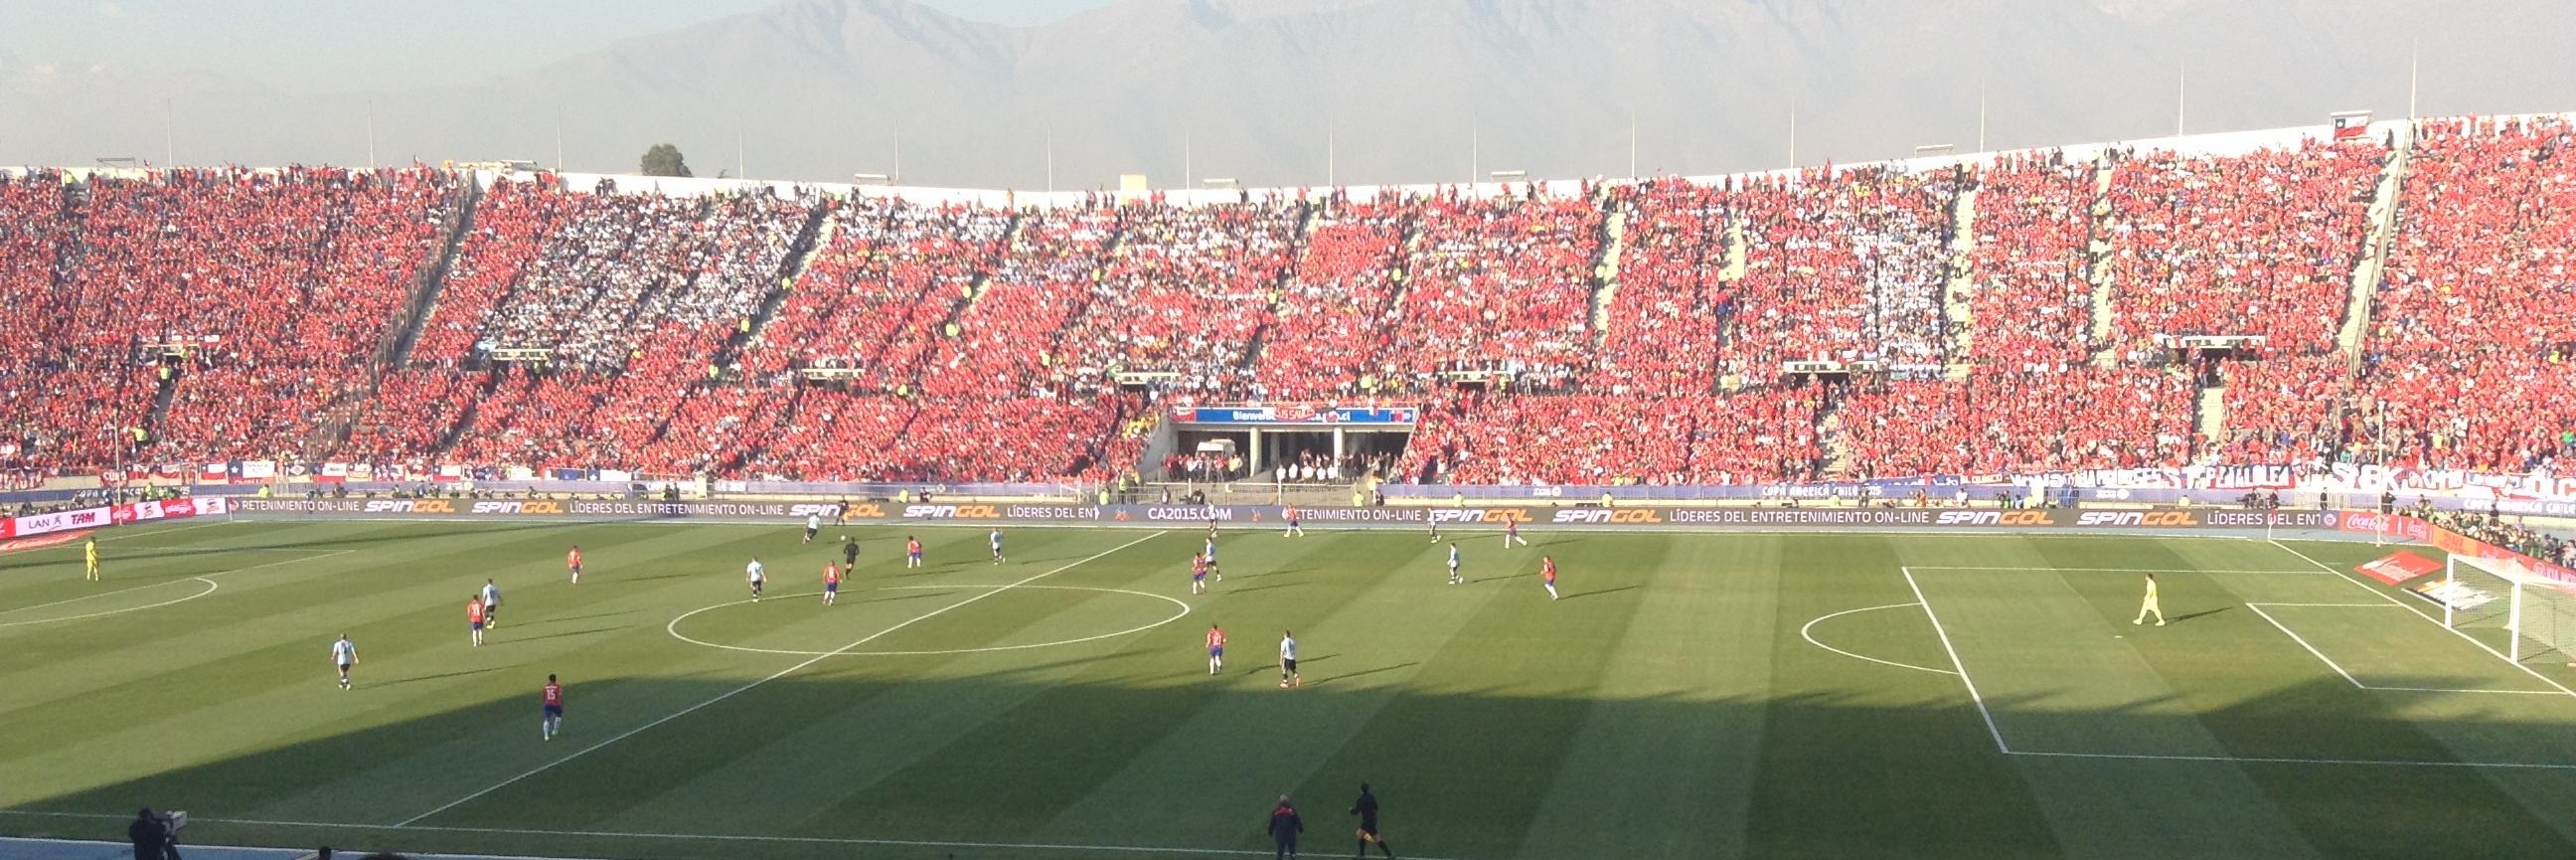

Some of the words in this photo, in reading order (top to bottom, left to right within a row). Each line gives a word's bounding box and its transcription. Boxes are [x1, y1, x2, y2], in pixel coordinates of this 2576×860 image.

[242, 501, 315, 512] RETENIMIENTO
[317, 501, 360, 511] ON-LINE
[569, 500, 612, 514] LÍDERES
[615, 503, 635, 514] DEL
[637, 503, 736, 515] ENTRETENIMIENTO
[739, 504, 784, 515] ON-LINE
[1007, 505, 1051, 518] LÍDERES
[1054, 507, 1075, 518] DEL
[71, 512, 95, 525] TAM
[1373, 509, 1421, 522] ON-LINE
[1670, 509, 1720, 523] LÍDERES
[1724, 511, 1748, 523] DEL
[1751, 511, 1871, 524] ENTRETENIMIENTO
[1874, 511, 1929, 524] ON-LINE
[2207, 510, 2263, 525] LÍDERES
[28, 518, 50, 530] LAN
